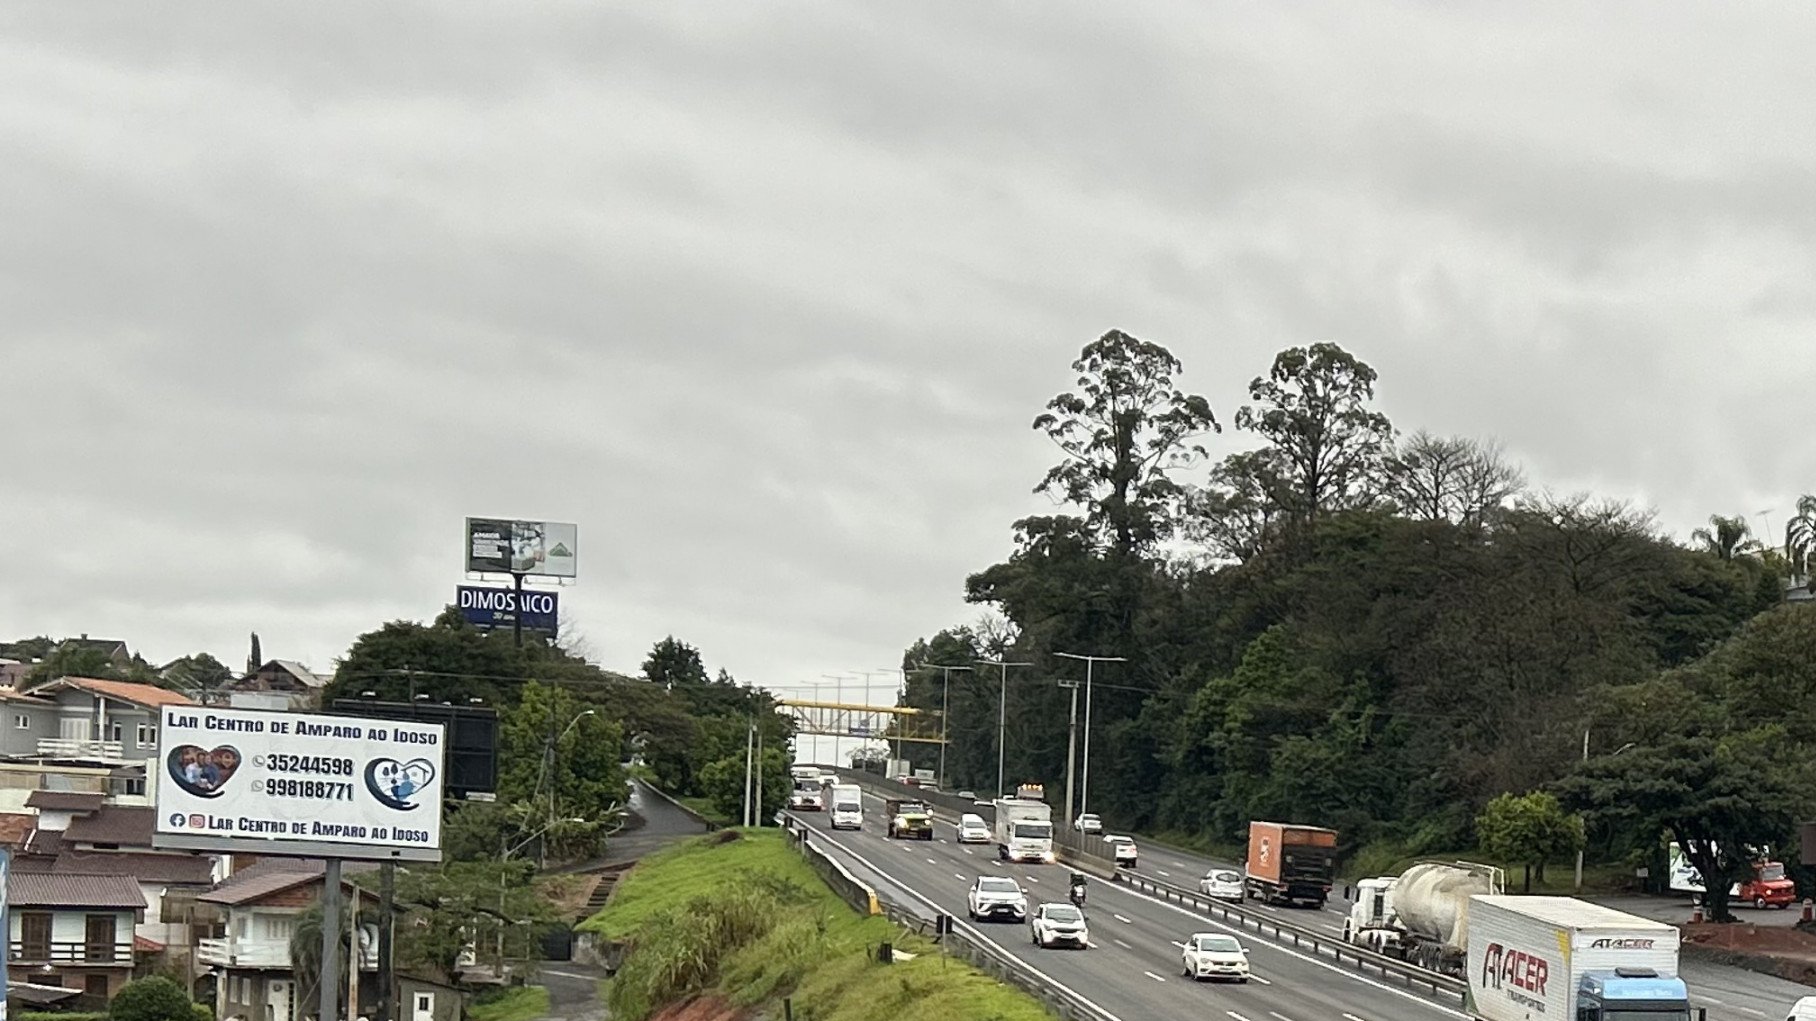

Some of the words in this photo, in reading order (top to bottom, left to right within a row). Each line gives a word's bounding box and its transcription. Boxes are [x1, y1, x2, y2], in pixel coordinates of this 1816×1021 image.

[168, 712, 198, 729] LAR
[205, 715, 264, 733] CENTRO
[270, 721, 290, 735] DE
[295, 720, 361, 739] AMPARO
[368, 727, 387, 742] AO
[393, 728, 438, 745] IDOSO
[266, 754, 353, 776] 35244598
[266, 778, 353, 801] 998188771
[209, 815, 233, 831] LAR
[238, 817, 287, 834] CENTRO
[292, 821, 307, 835] DE
[312, 821, 366, 838] AMPARO
[371, 826, 387, 840] AO
[392, 826, 429, 843] IDOSO
[1502, 949, 1548, 997] ACER
